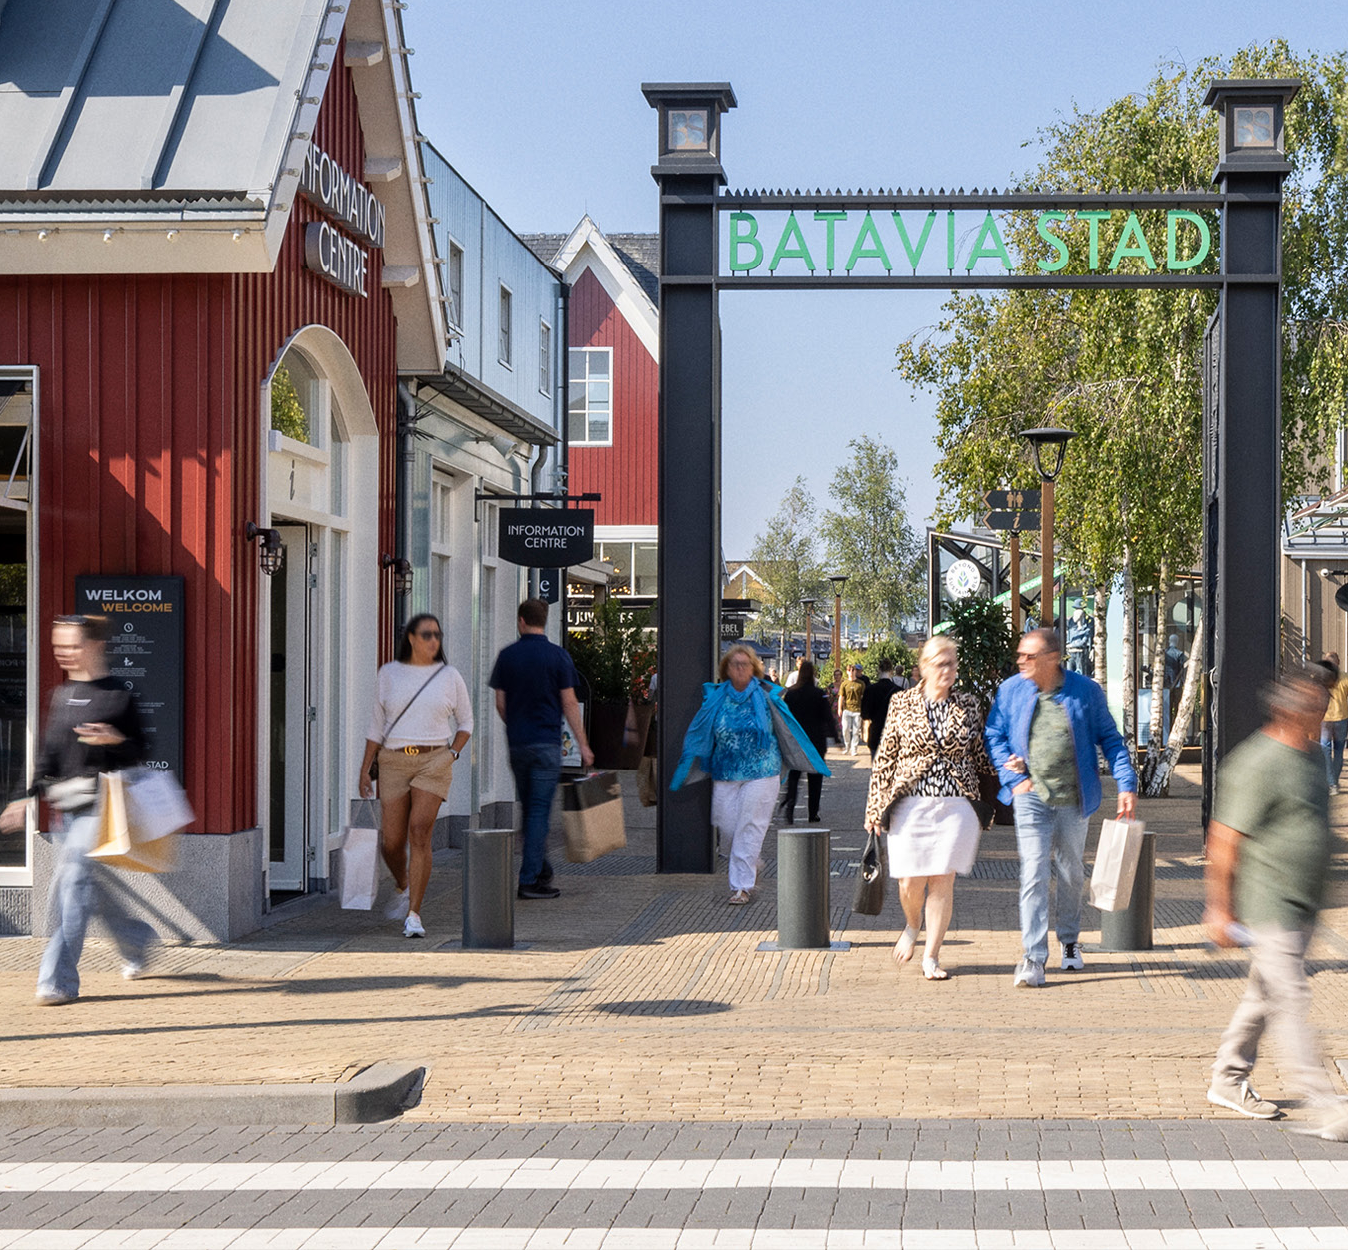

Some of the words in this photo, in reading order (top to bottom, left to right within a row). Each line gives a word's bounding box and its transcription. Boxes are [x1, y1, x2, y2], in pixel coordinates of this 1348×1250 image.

[301, 140, 386, 248] NFORMATION
[729, 211, 1014, 272] BATAVIA
[1037, 210, 1211, 272] STAD
[318, 220, 368, 298] CENTRE
[508, 525, 585, 536] INFORMATION
[524, 537, 568, 549] CENTRE
[85, 589, 162, 601] WELKOM
[101, 603, 173, 612] WELCOME
[146, 760, 169, 769] STAD
